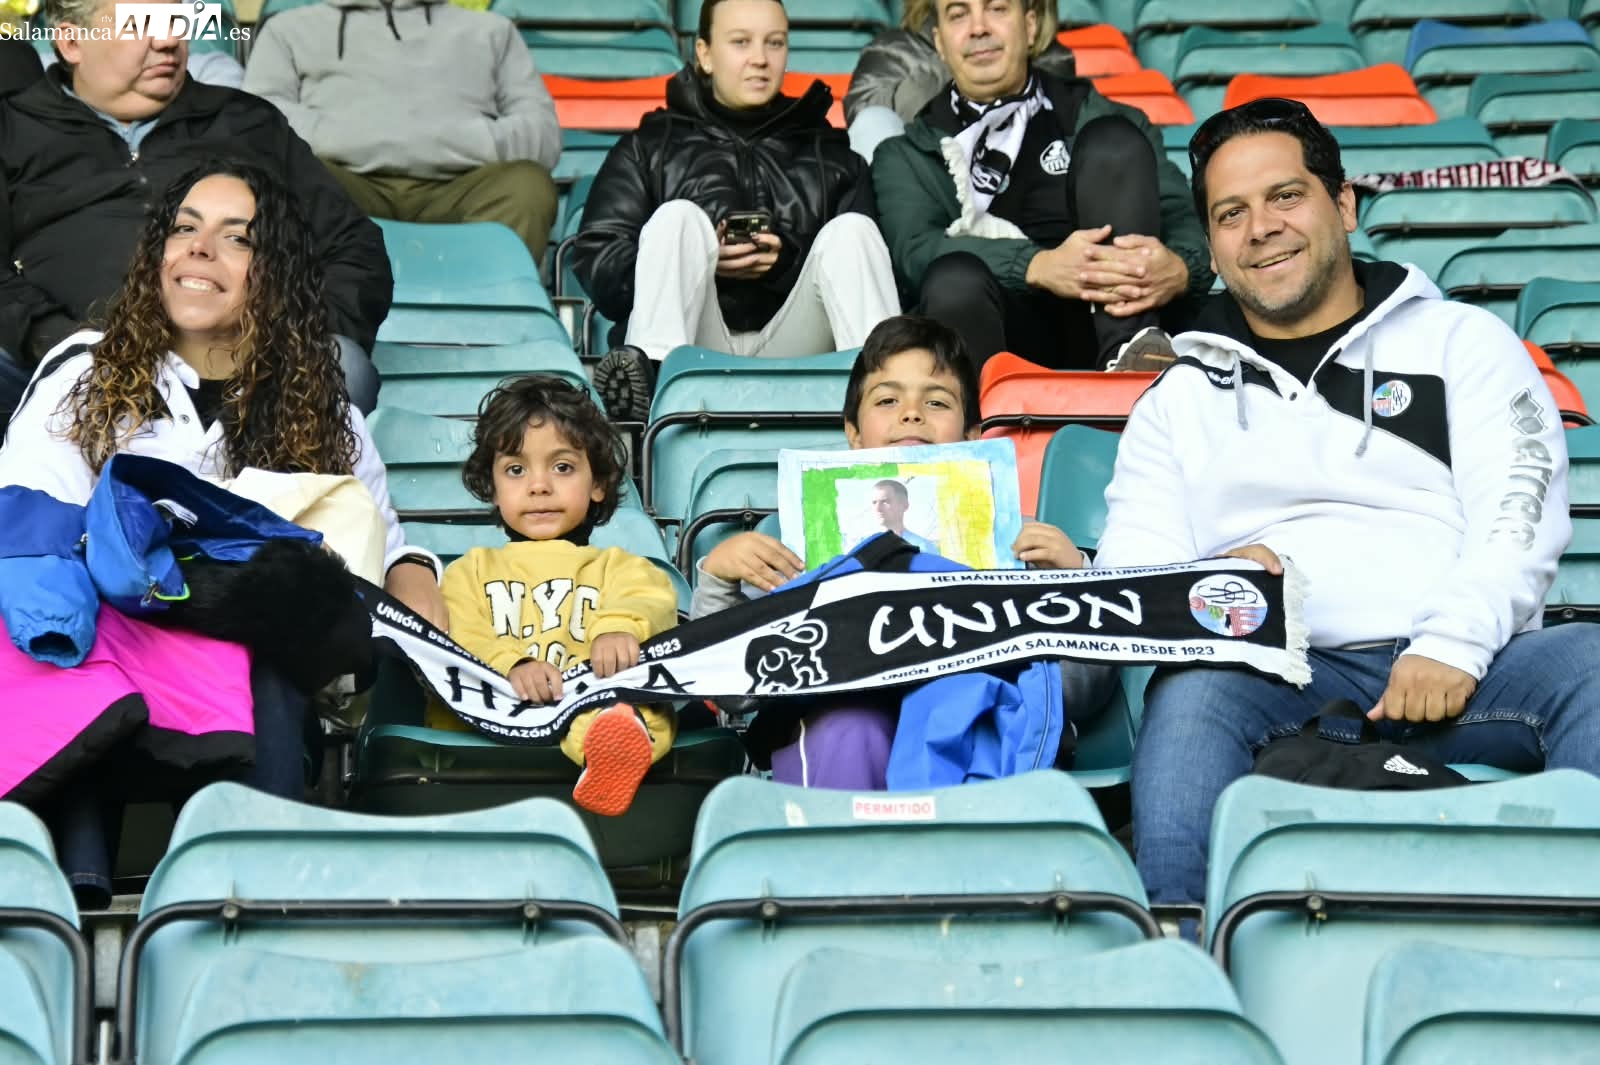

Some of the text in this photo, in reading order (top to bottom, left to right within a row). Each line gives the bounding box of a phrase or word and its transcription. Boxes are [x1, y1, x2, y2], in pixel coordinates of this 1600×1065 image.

[931, 572, 1035, 583] HELMÁNTICO,
[1040, 570, 1112, 582] CORAZÓN
[376, 602, 423, 633] UNIÓN
[869, 589, 1143, 655] UNIÓN
[648, 638, 682, 659] 1923
[882, 667, 929, 681] UNIÓN
[938, 645, 1021, 671] DEPORTIVA
[1026, 638, 1120, 652] SALAMANCA
[1132, 643, 1177, 656] DESDE
[1181, 646, 1215, 656] 1923
[480, 690, 617, 739] CORAZÓN UNIONISTA
[855, 802, 931, 815] PERMITIDO
